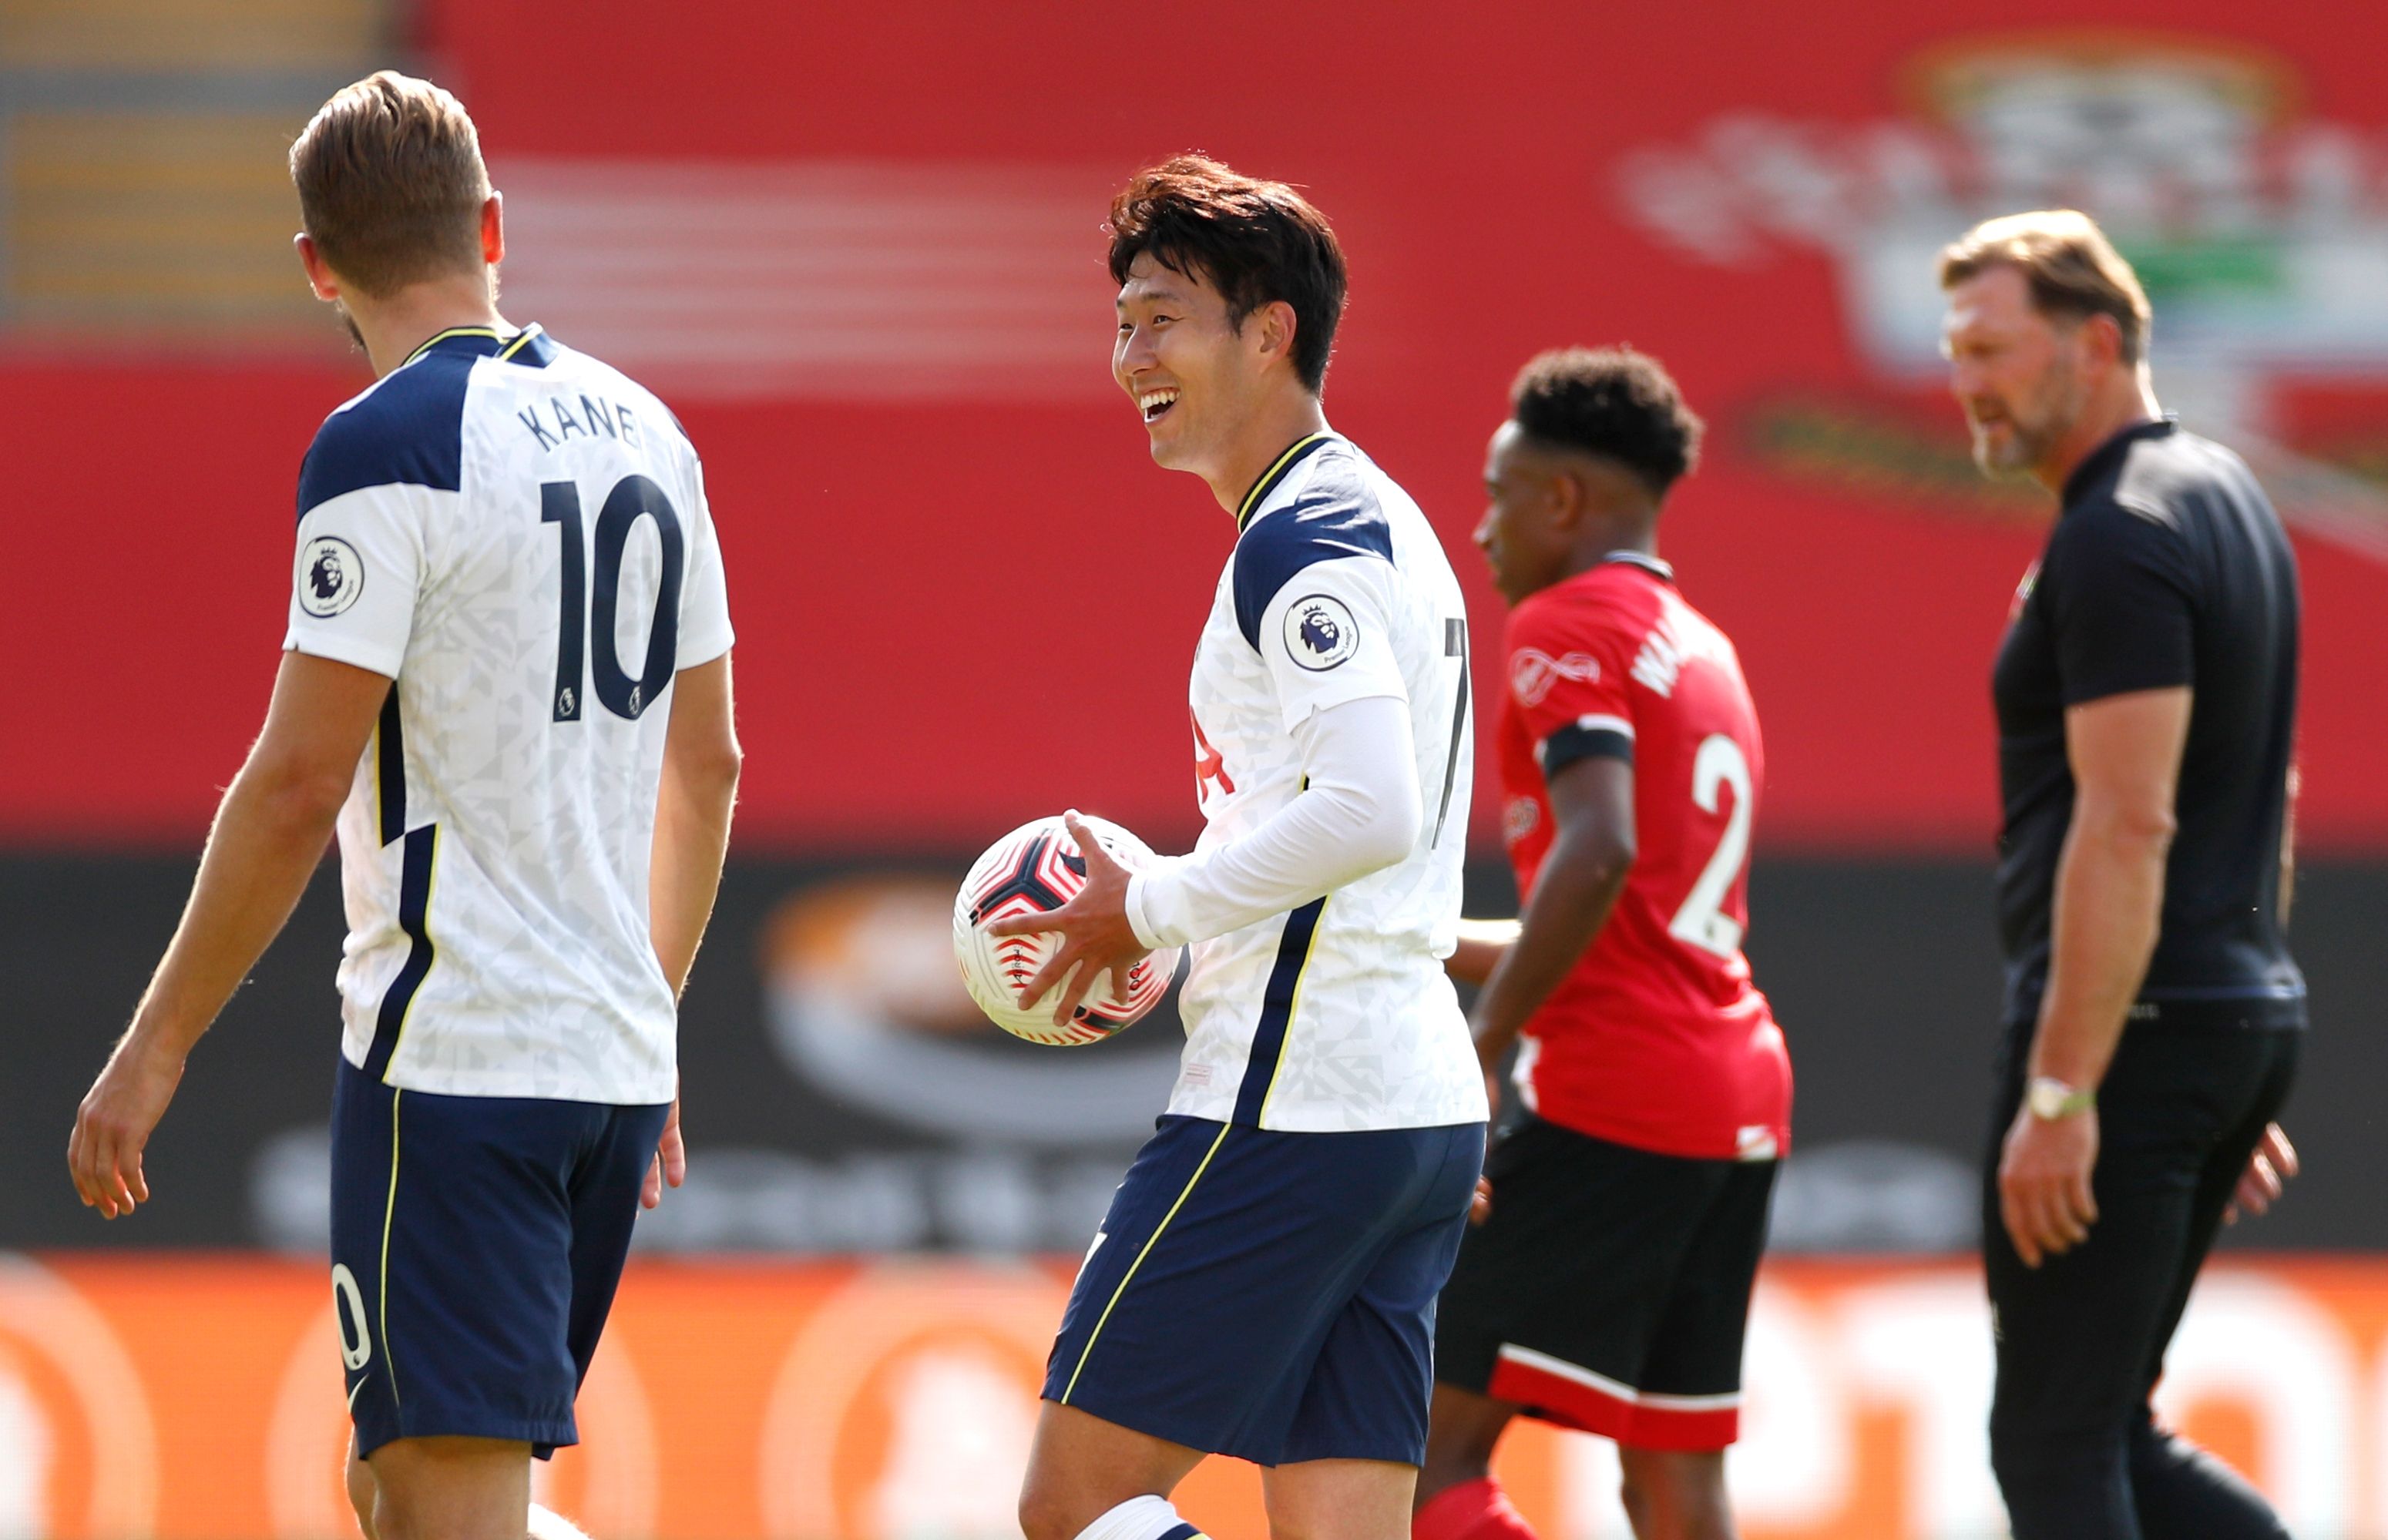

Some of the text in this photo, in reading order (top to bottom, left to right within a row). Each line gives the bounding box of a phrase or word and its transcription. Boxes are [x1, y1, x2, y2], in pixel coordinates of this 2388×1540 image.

[518, 394, 640, 453] KANE
[540, 475, 683, 720] 10
[1431, 618, 1468, 850] 7
[1668, 734, 1752, 957] 2
[331, 1263, 371, 1371] 0
